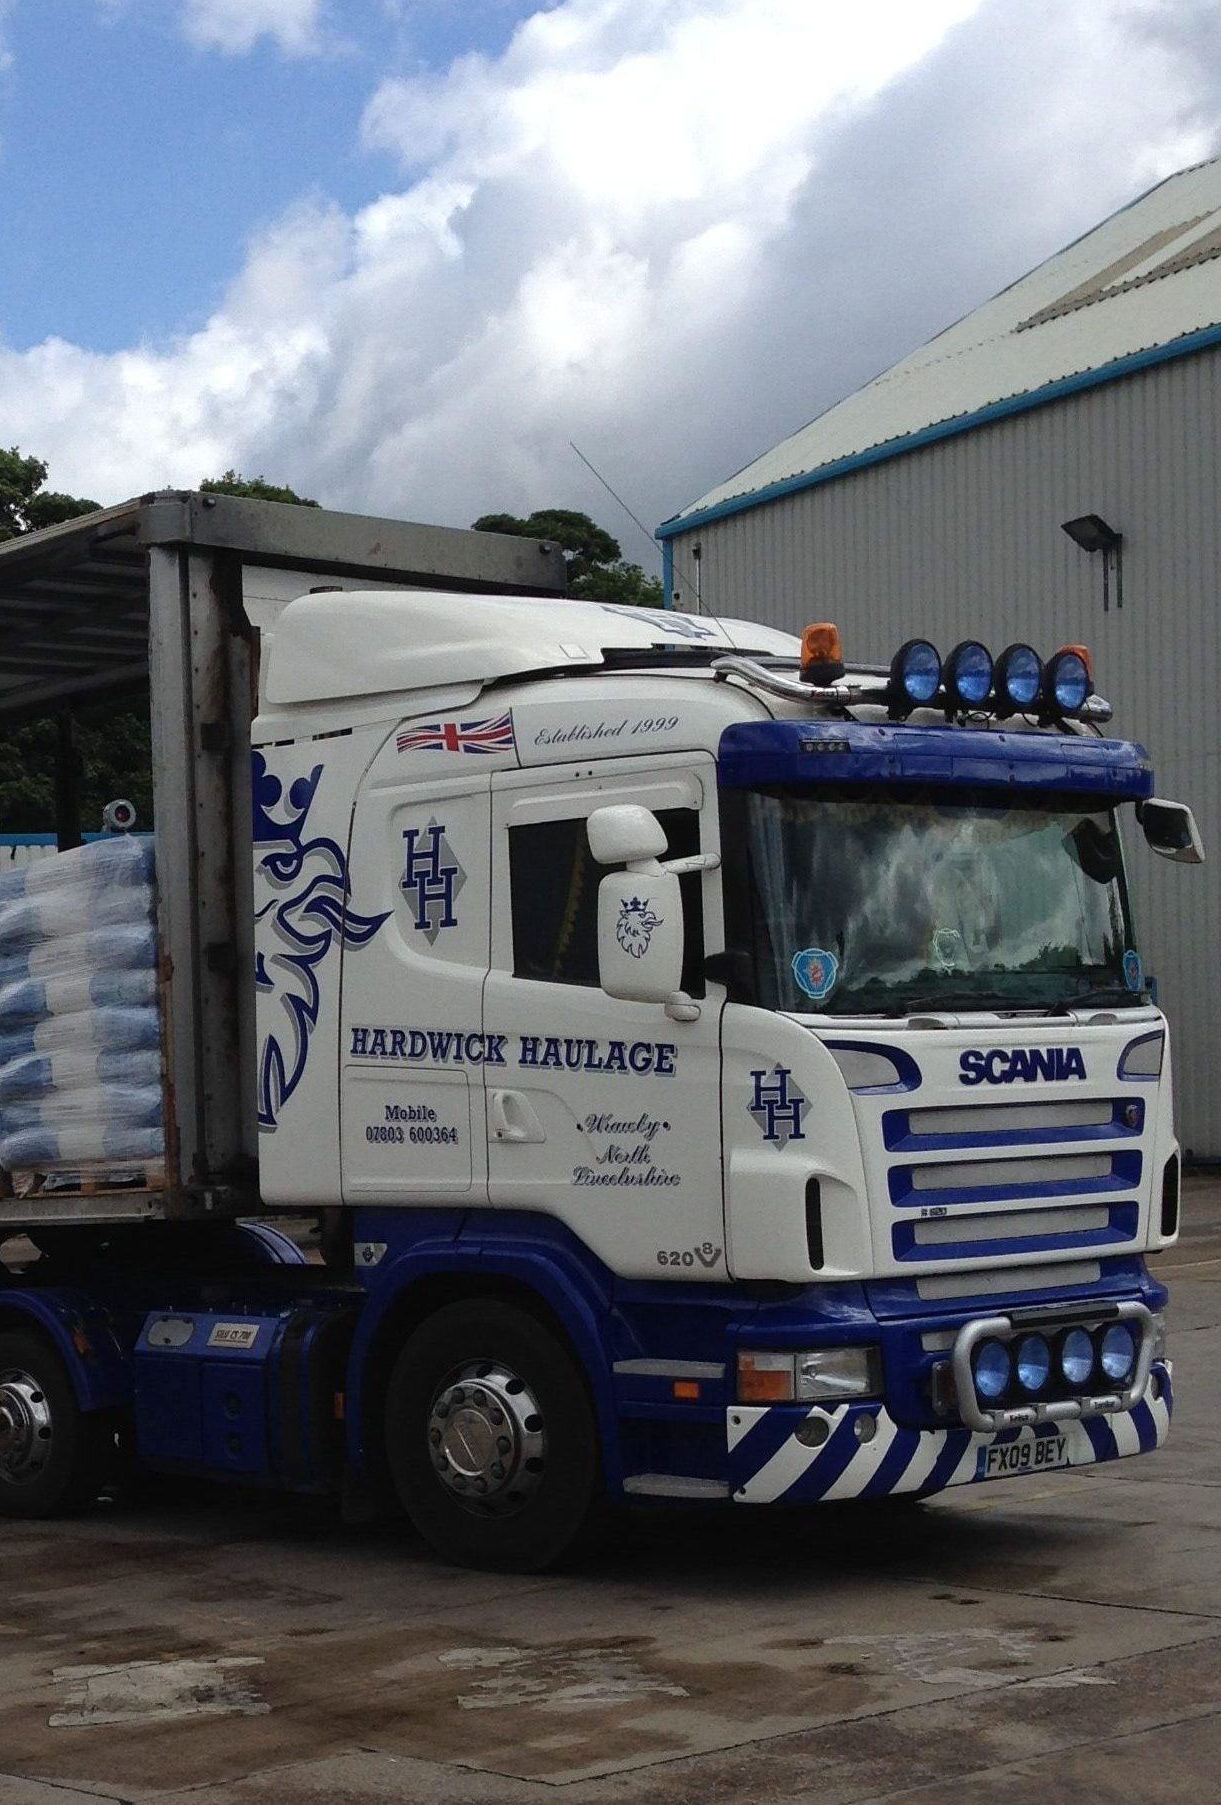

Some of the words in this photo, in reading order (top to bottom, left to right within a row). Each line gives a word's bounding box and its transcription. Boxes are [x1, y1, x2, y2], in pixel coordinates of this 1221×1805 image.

[534, 719, 629, 746] Established
[630, 716, 679, 735] 1999
[350, 1027, 507, 1067] HARDWICK
[518, 1036, 678, 1076] HAULAGE
[958, 1047, 1087, 1086] SCANIA
[384, 1104, 436, 1122] Mobile
[365, 1126, 404, 1144] 07803
[409, 1126, 459, 1145] 600364
[596, 1144, 652, 1164] North
[572, 1166, 681, 1186] Lincolnshire
[657, 1251, 694, 1267] 620
[986, 1442, 1030, 1473] FX09
[1034, 1437, 1067, 1465] BEY
